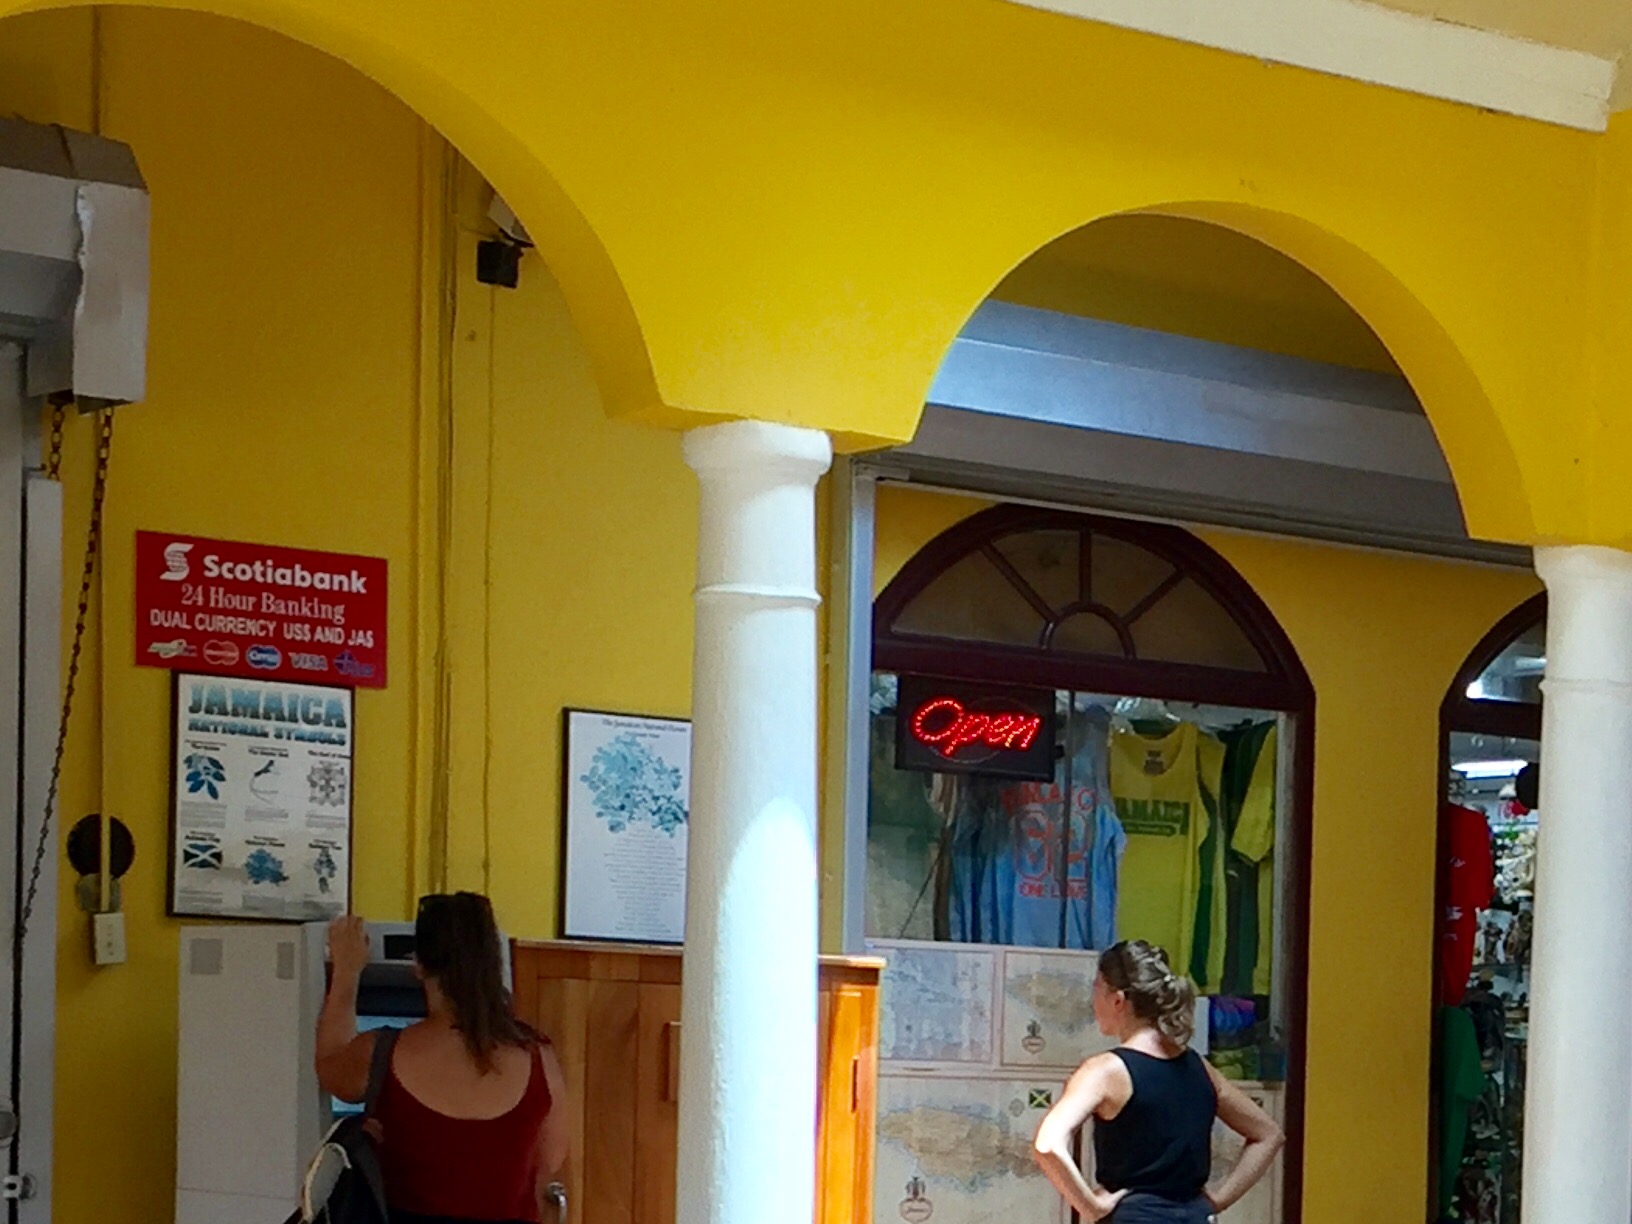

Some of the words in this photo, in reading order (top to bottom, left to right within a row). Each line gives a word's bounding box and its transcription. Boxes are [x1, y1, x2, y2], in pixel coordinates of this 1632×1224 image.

[203, 553, 368, 594] Scotiabank
[181, 582, 204, 608] 24
[209, 586, 257, 613] Hour
[260, 591, 346, 625] Banking
[150, 608, 193, 631] DUAL
[194, 612, 277, 637] CURRENCY
[314, 625, 345, 646] AND
[188, 684, 347, 728] JAMAICA
[914, 698, 1042, 756] Open
